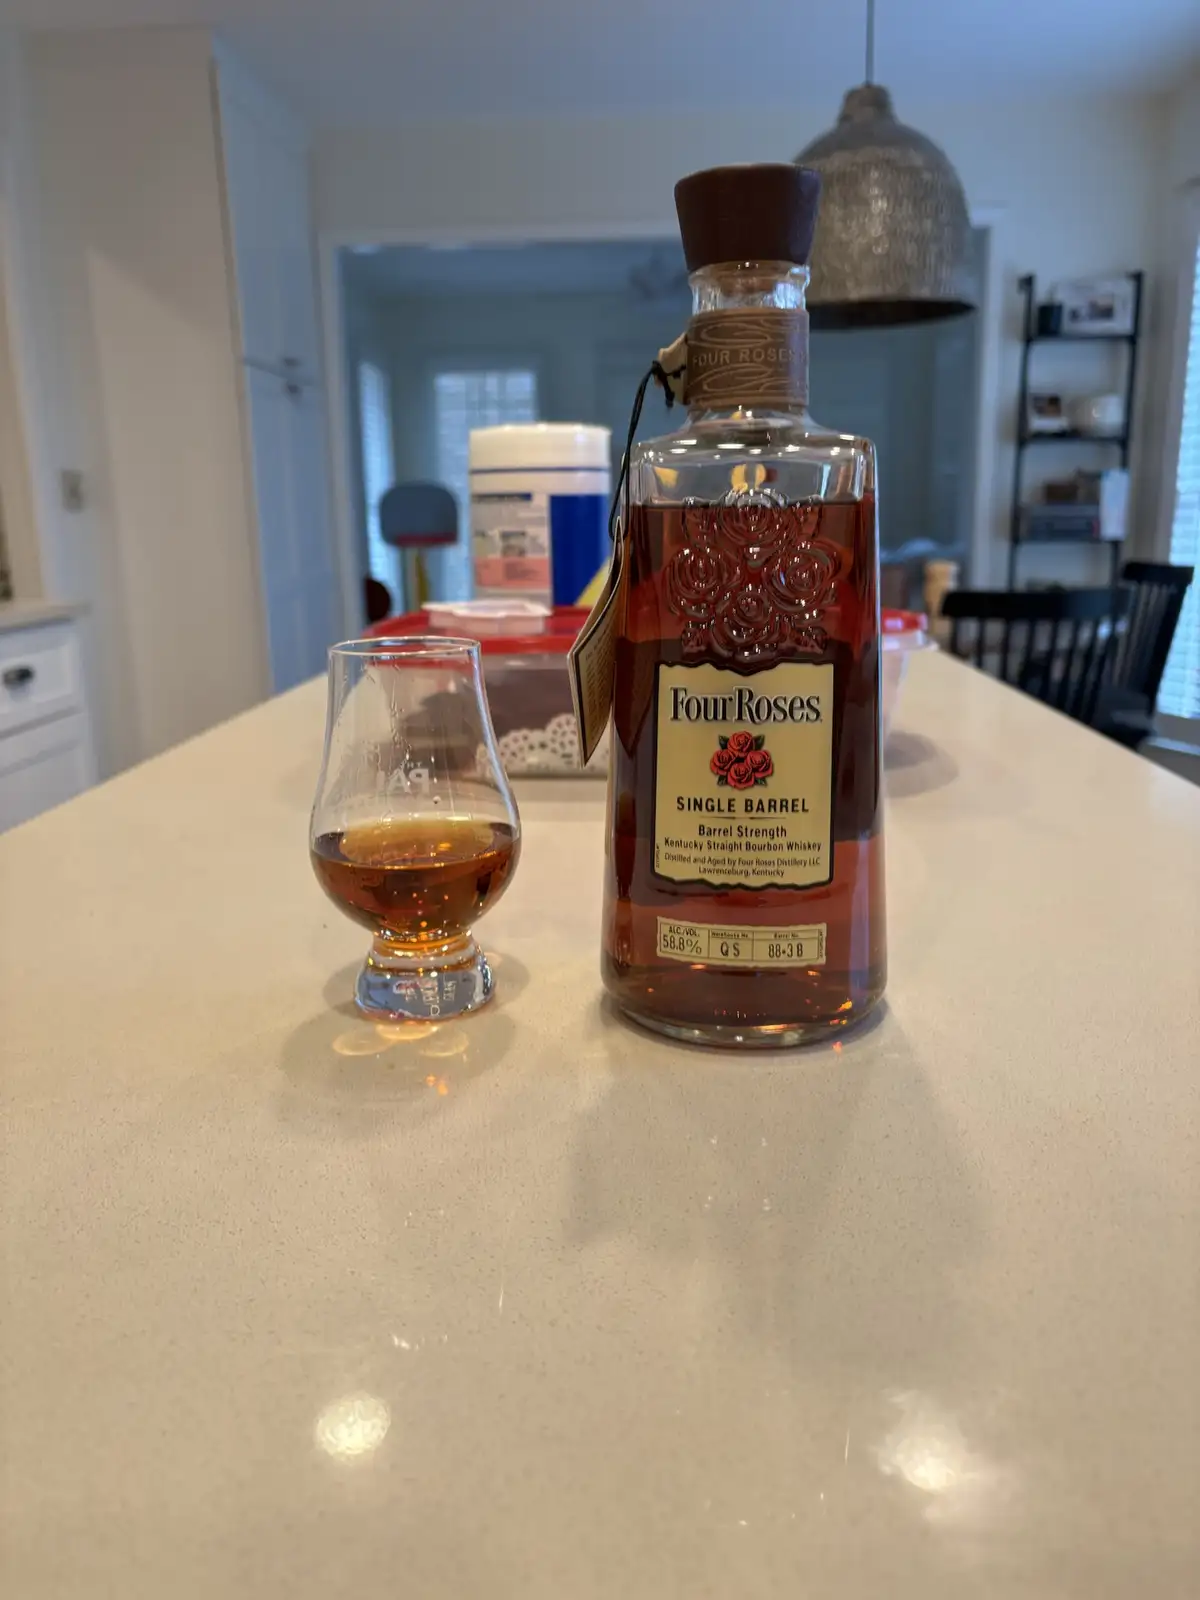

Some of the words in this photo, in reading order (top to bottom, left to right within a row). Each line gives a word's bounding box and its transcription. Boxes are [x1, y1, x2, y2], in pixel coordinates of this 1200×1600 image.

[692, 351, 730, 366] FOUR
[670, 685, 733, 722] Four
[734, 685, 821, 725] Roses
[676, 796, 737, 813] SINGLE
[744, 798, 809, 814] BARREL
[698, 824, 733, 837] Barrel
[737, 825, 787, 840] Strength
[664, 837, 704, 852] Kentucky
[706, 839, 742, 853] Straight
[745, 841, 784, 852] Bourbon
[786, 840, 822, 852] Whiskey
[664, 852, 692, 864] Distilled
[692, 856, 706, 865] and
[707, 856, 726, 866] Aged
[727, 857, 737, 867] by
[738, 857, 754, 866] Four
[755, 857, 776, 866] Roses
[776, 858, 808, 868] Distillery
[808, 857, 821, 867] LLC
[751, 867, 785, 878] Kentucky
[663, 934, 702, 955] 58.8%
